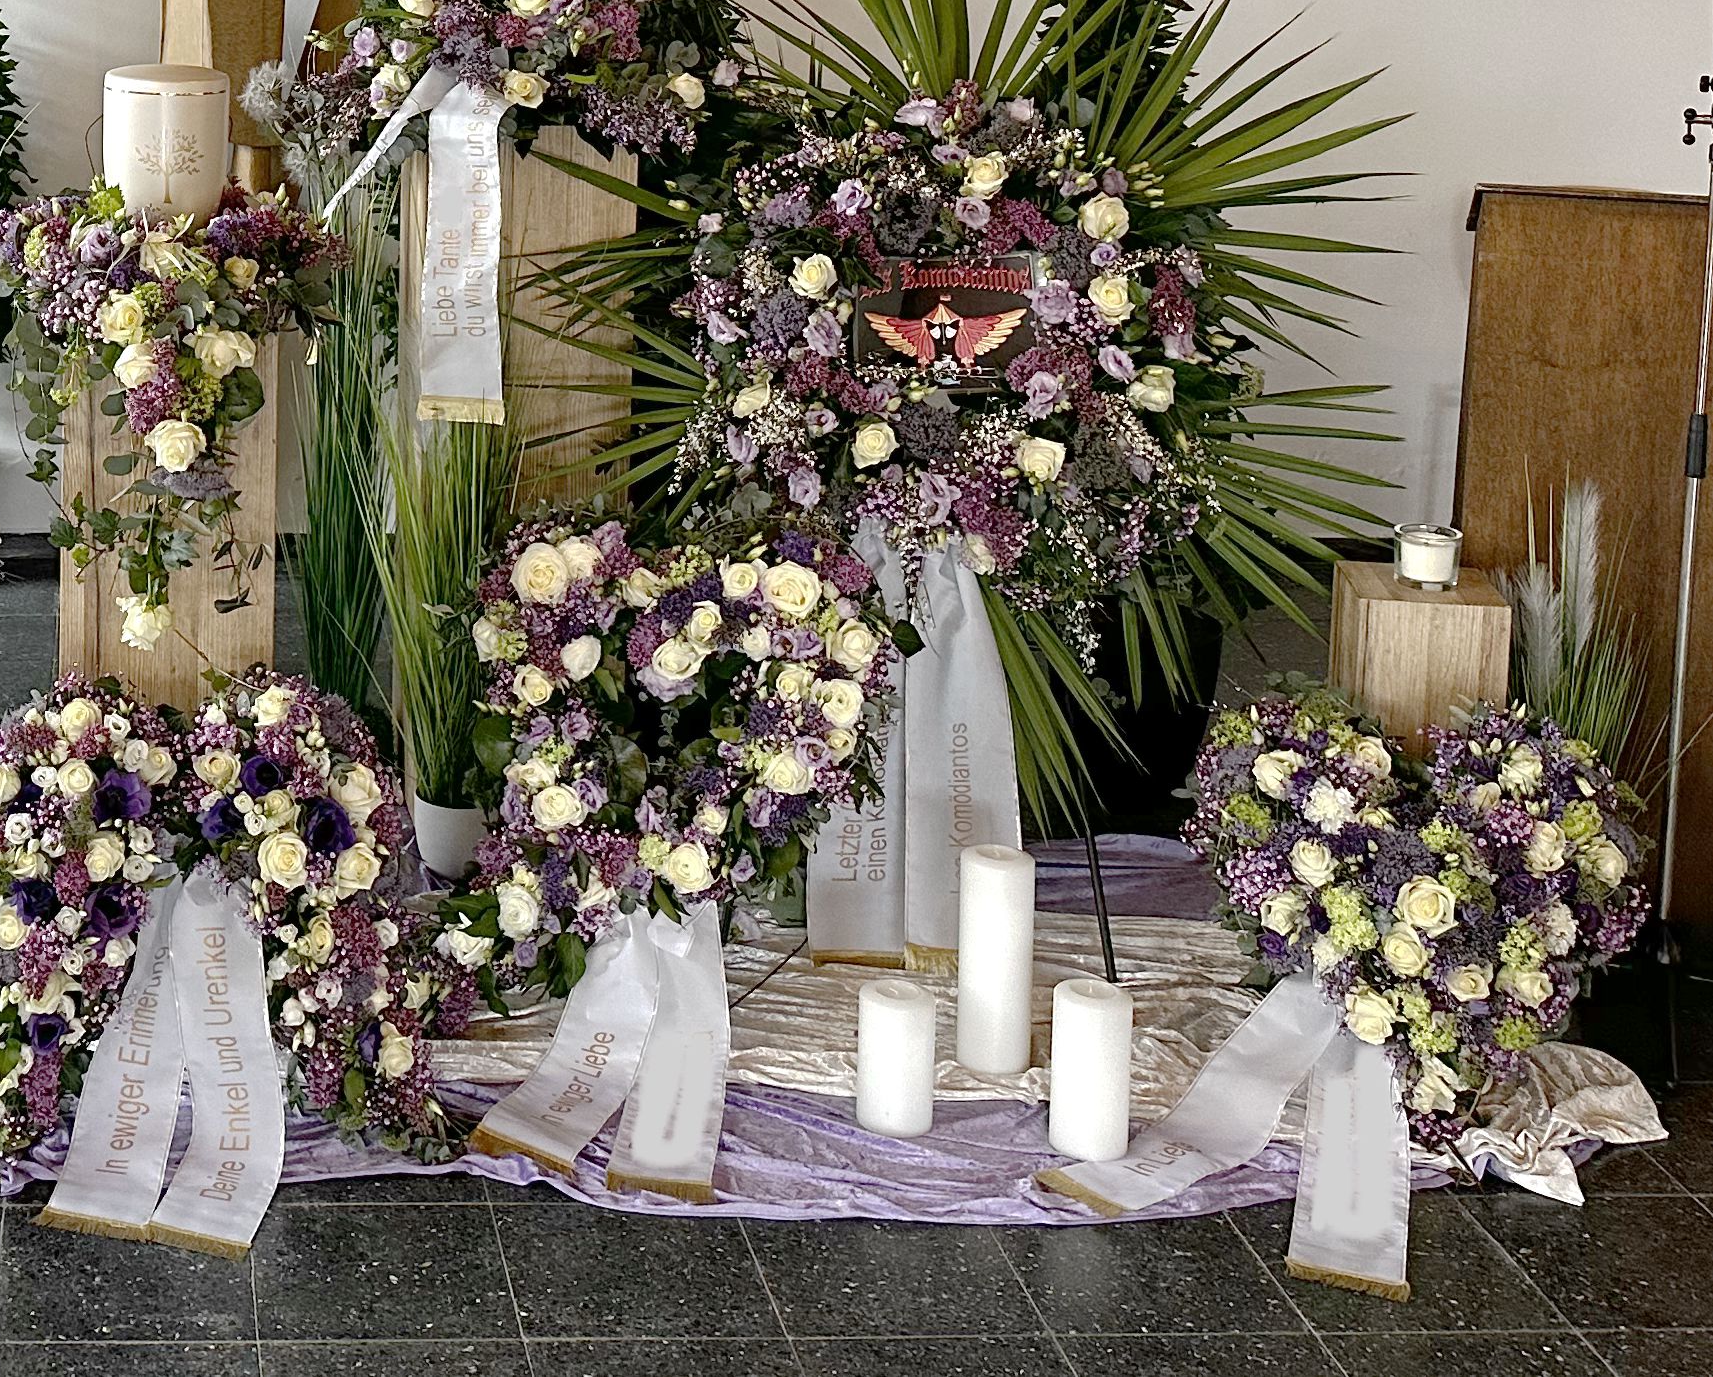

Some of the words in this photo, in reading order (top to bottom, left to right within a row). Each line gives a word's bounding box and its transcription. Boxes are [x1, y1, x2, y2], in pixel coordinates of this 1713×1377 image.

[466, 121, 485, 159] uns
[466, 164, 490, 195] bei
[432, 228, 461, 280] Tante
[464, 202, 490, 259] immer
[432, 285, 458, 338] Liebe
[459, 262, 485, 309] wirst
[462, 316, 487, 338] du
[947, 722, 974, 848] Komödiantos
[831, 816, 863, 883] Letzter
[863, 827, 888, 882] einen
[195, 926, 234, 1026] Urenkel
[118, 946, 170, 1067] Erinnerung
[208, 1035, 244, 1074] und
[569, 1031, 616, 1079] Liebe
[108, 1073, 150, 1152] ewiger
[218, 1083, 251, 1152] Enkel
[96, 1158, 129, 1175] In
[199, 1159, 246, 1202] Deine
[1122, 1162, 1161, 1177] In
